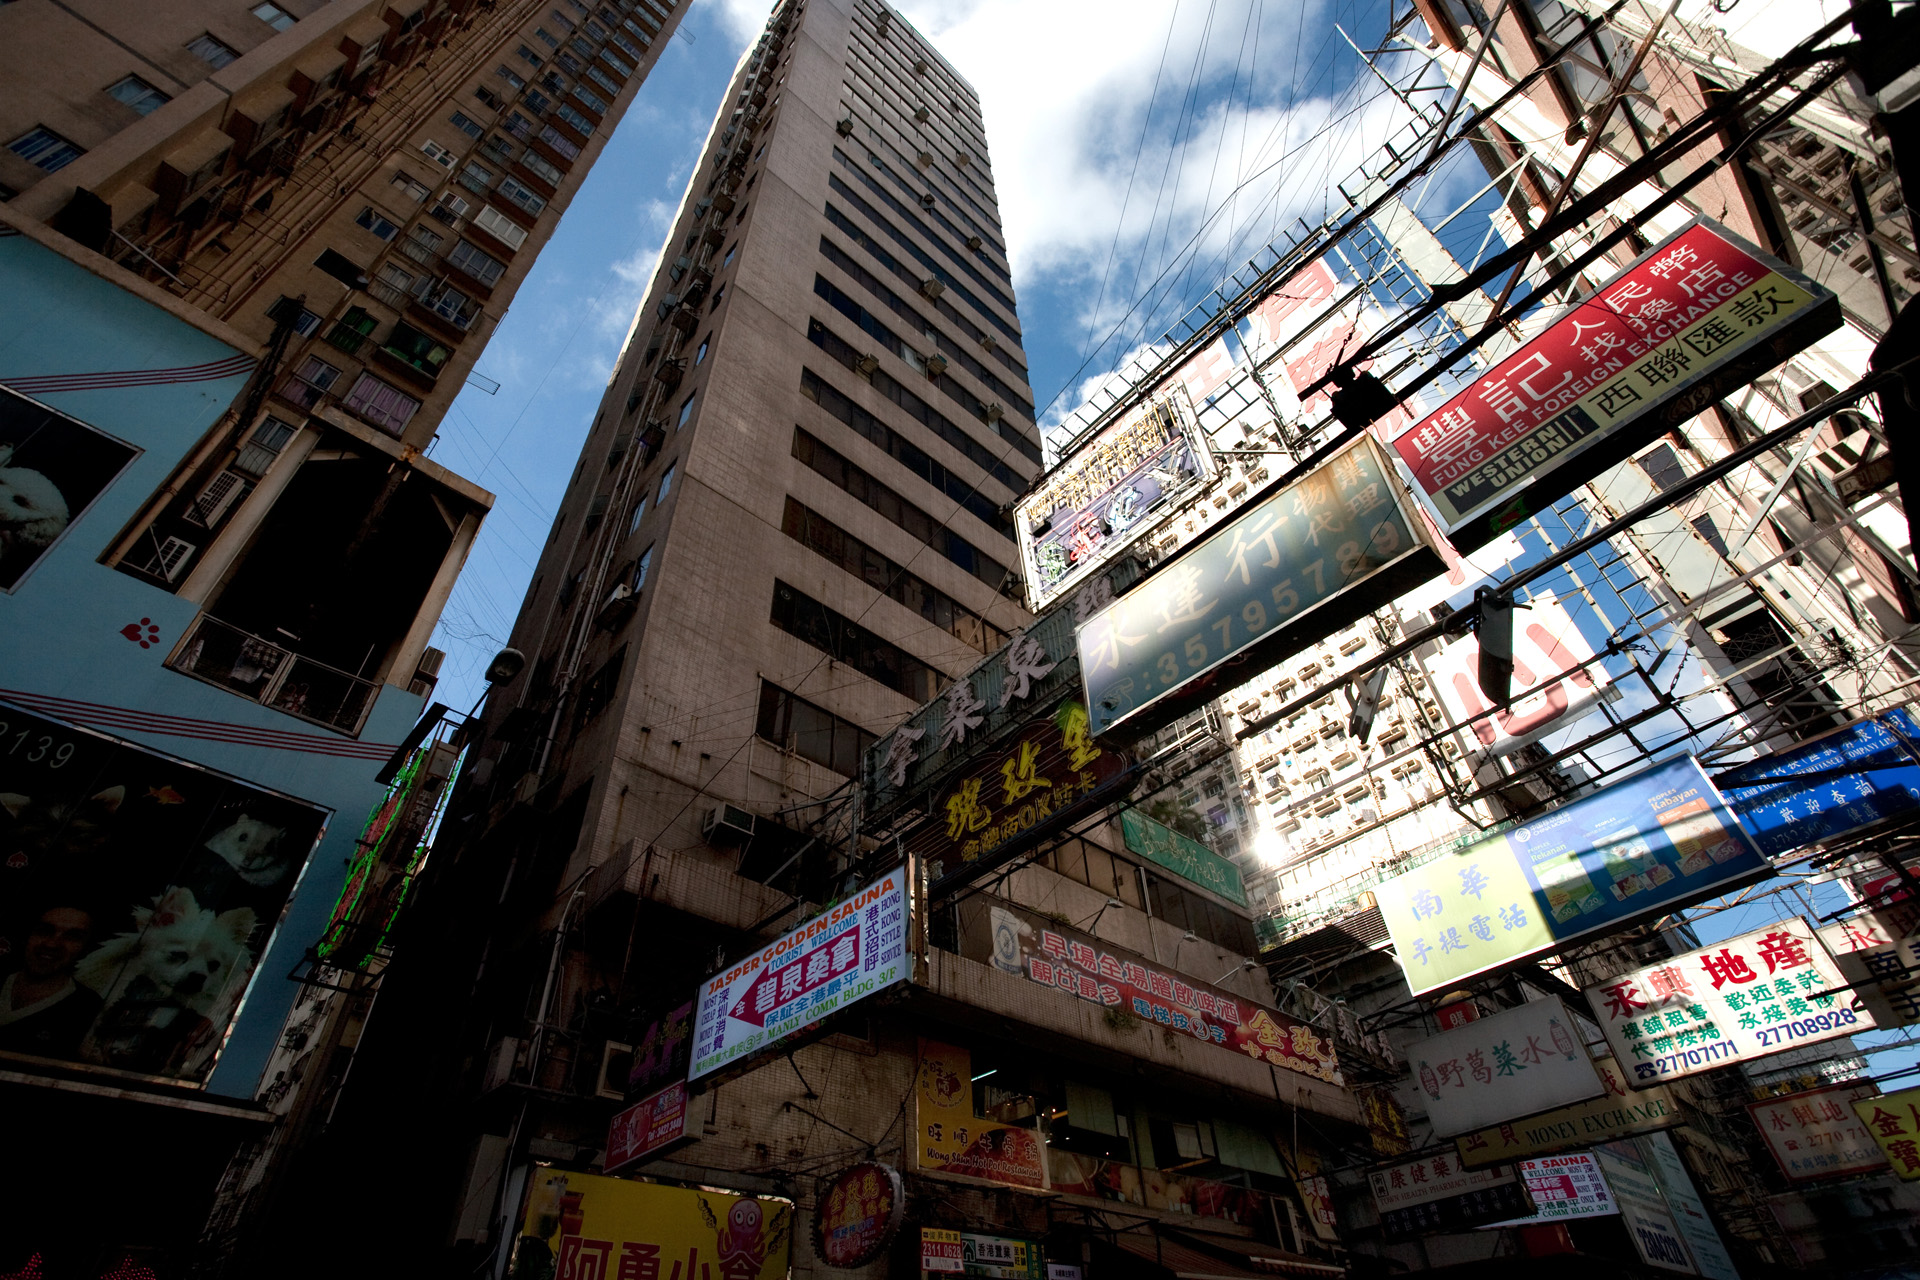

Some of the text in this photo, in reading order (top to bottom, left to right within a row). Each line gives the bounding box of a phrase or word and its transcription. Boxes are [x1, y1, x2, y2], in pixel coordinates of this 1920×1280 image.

[1569, 243, 1700, 347] 人民幣
[1580, 259, 1726, 367] 找換店
[1433, 270, 1754, 487] FUNG KEE FOREIGN EXCHANGE
[1587, 285, 1795, 419] 西聯匯款
[1411, 351, 1573, 474] 豐記
[1293, 451, 1369, 518] 物業
[1450, 424, 1559, 499] WESTERN
[1491, 434, 1570, 489] UNION
[1303, 482, 1388, 547] 代理
[1651, 787, 1698, 812] Kabayan
[881, 891, 901, 912] HONG
[881, 910, 901, 930] KONG
[708, 877, 895, 996] JASPER GOLDEN SAUNA
[770, 912, 859, 972] TOURIST WELLCOME
[881, 926, 901, 948] STYLE
[881, 944, 901, 966] SERVICE
[1411, 902, 1529, 966] 手提電話
[702, 993, 718, 1012] MOST
[767, 966, 898, 1039] MANLY COMM BLDG 3/F
[1249, 1009, 1340, 1064] 金玫
[1656, 1007, 1858, 1075] 27707171 27708928
[1525, 1099, 1671, 1147] MONEY EXCHANGE
[1806, 1132, 1844, 1148] 2770
[927, 1146, 950, 1165] Wong
[951, 1151, 972, 1166] Shun
[1002, 1161, 1042, 1178] Restaurant
[1389, 1155, 1462, 1189] 康健藥
[1401, 1188, 1427, 1201] HEALTH
[1429, 1178, 1468, 1194] PHARMACY
[1542, 1155, 1591, 1170] SAUNA
[1542, 1207, 1570, 1219] COMM
[1571, 1204, 1596, 1215] BLDG
[922, 1242, 941, 1256] 2311
